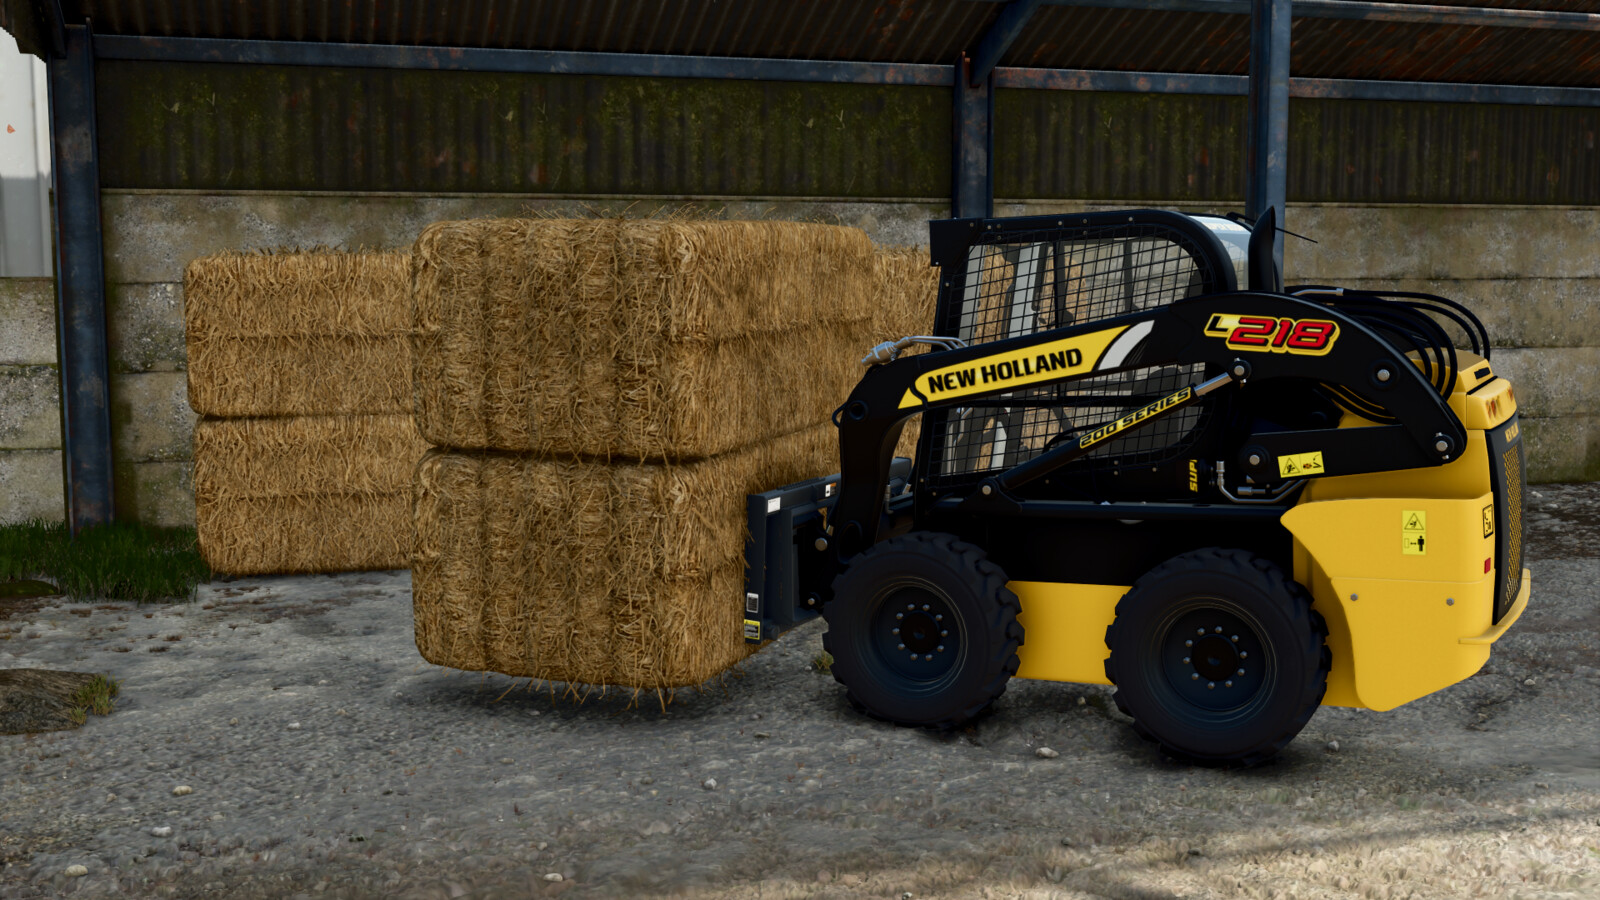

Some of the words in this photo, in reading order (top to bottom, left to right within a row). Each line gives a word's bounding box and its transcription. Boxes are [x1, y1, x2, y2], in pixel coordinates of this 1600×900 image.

[1206, 313, 1339, 354] L218
[928, 368, 976, 394] NEW
[981, 348, 1083, 384] HOLLAND
[1079, 421, 1118, 449] 200
[1122, 388, 1190, 428] SERIES
[1189, 459, 1198, 493] SUP
